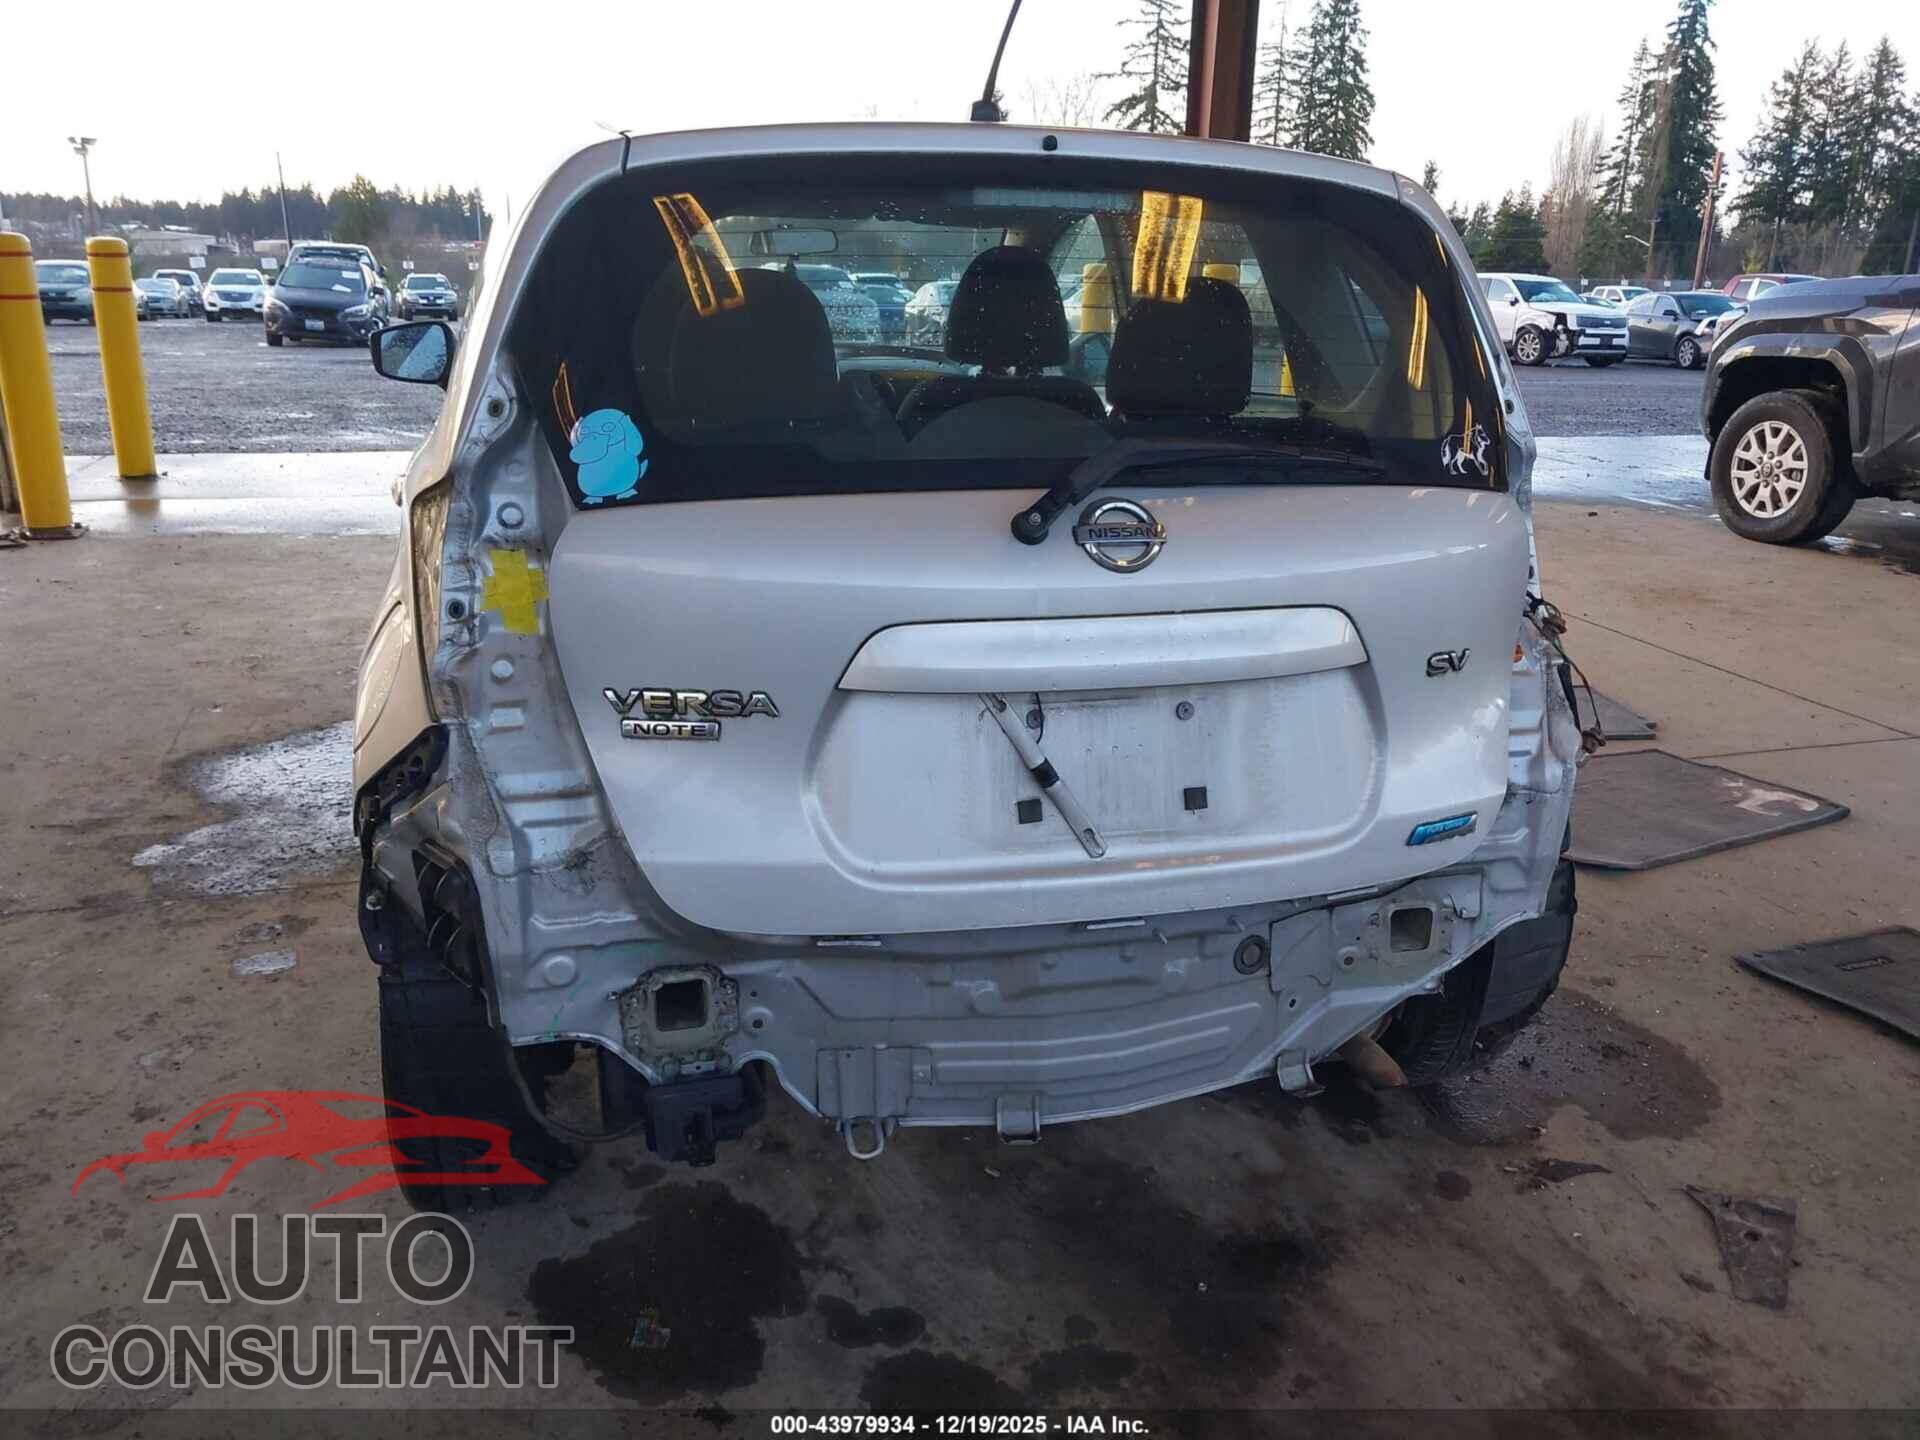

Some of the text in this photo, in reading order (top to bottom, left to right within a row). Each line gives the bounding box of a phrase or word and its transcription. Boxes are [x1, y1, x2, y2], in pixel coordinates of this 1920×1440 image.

[1087, 526, 1158, 539] NISSAN
[1427, 648, 1471, 677] SV
[603, 687, 780, 718] VERSA
[632, 723, 708, 737] NOTE
